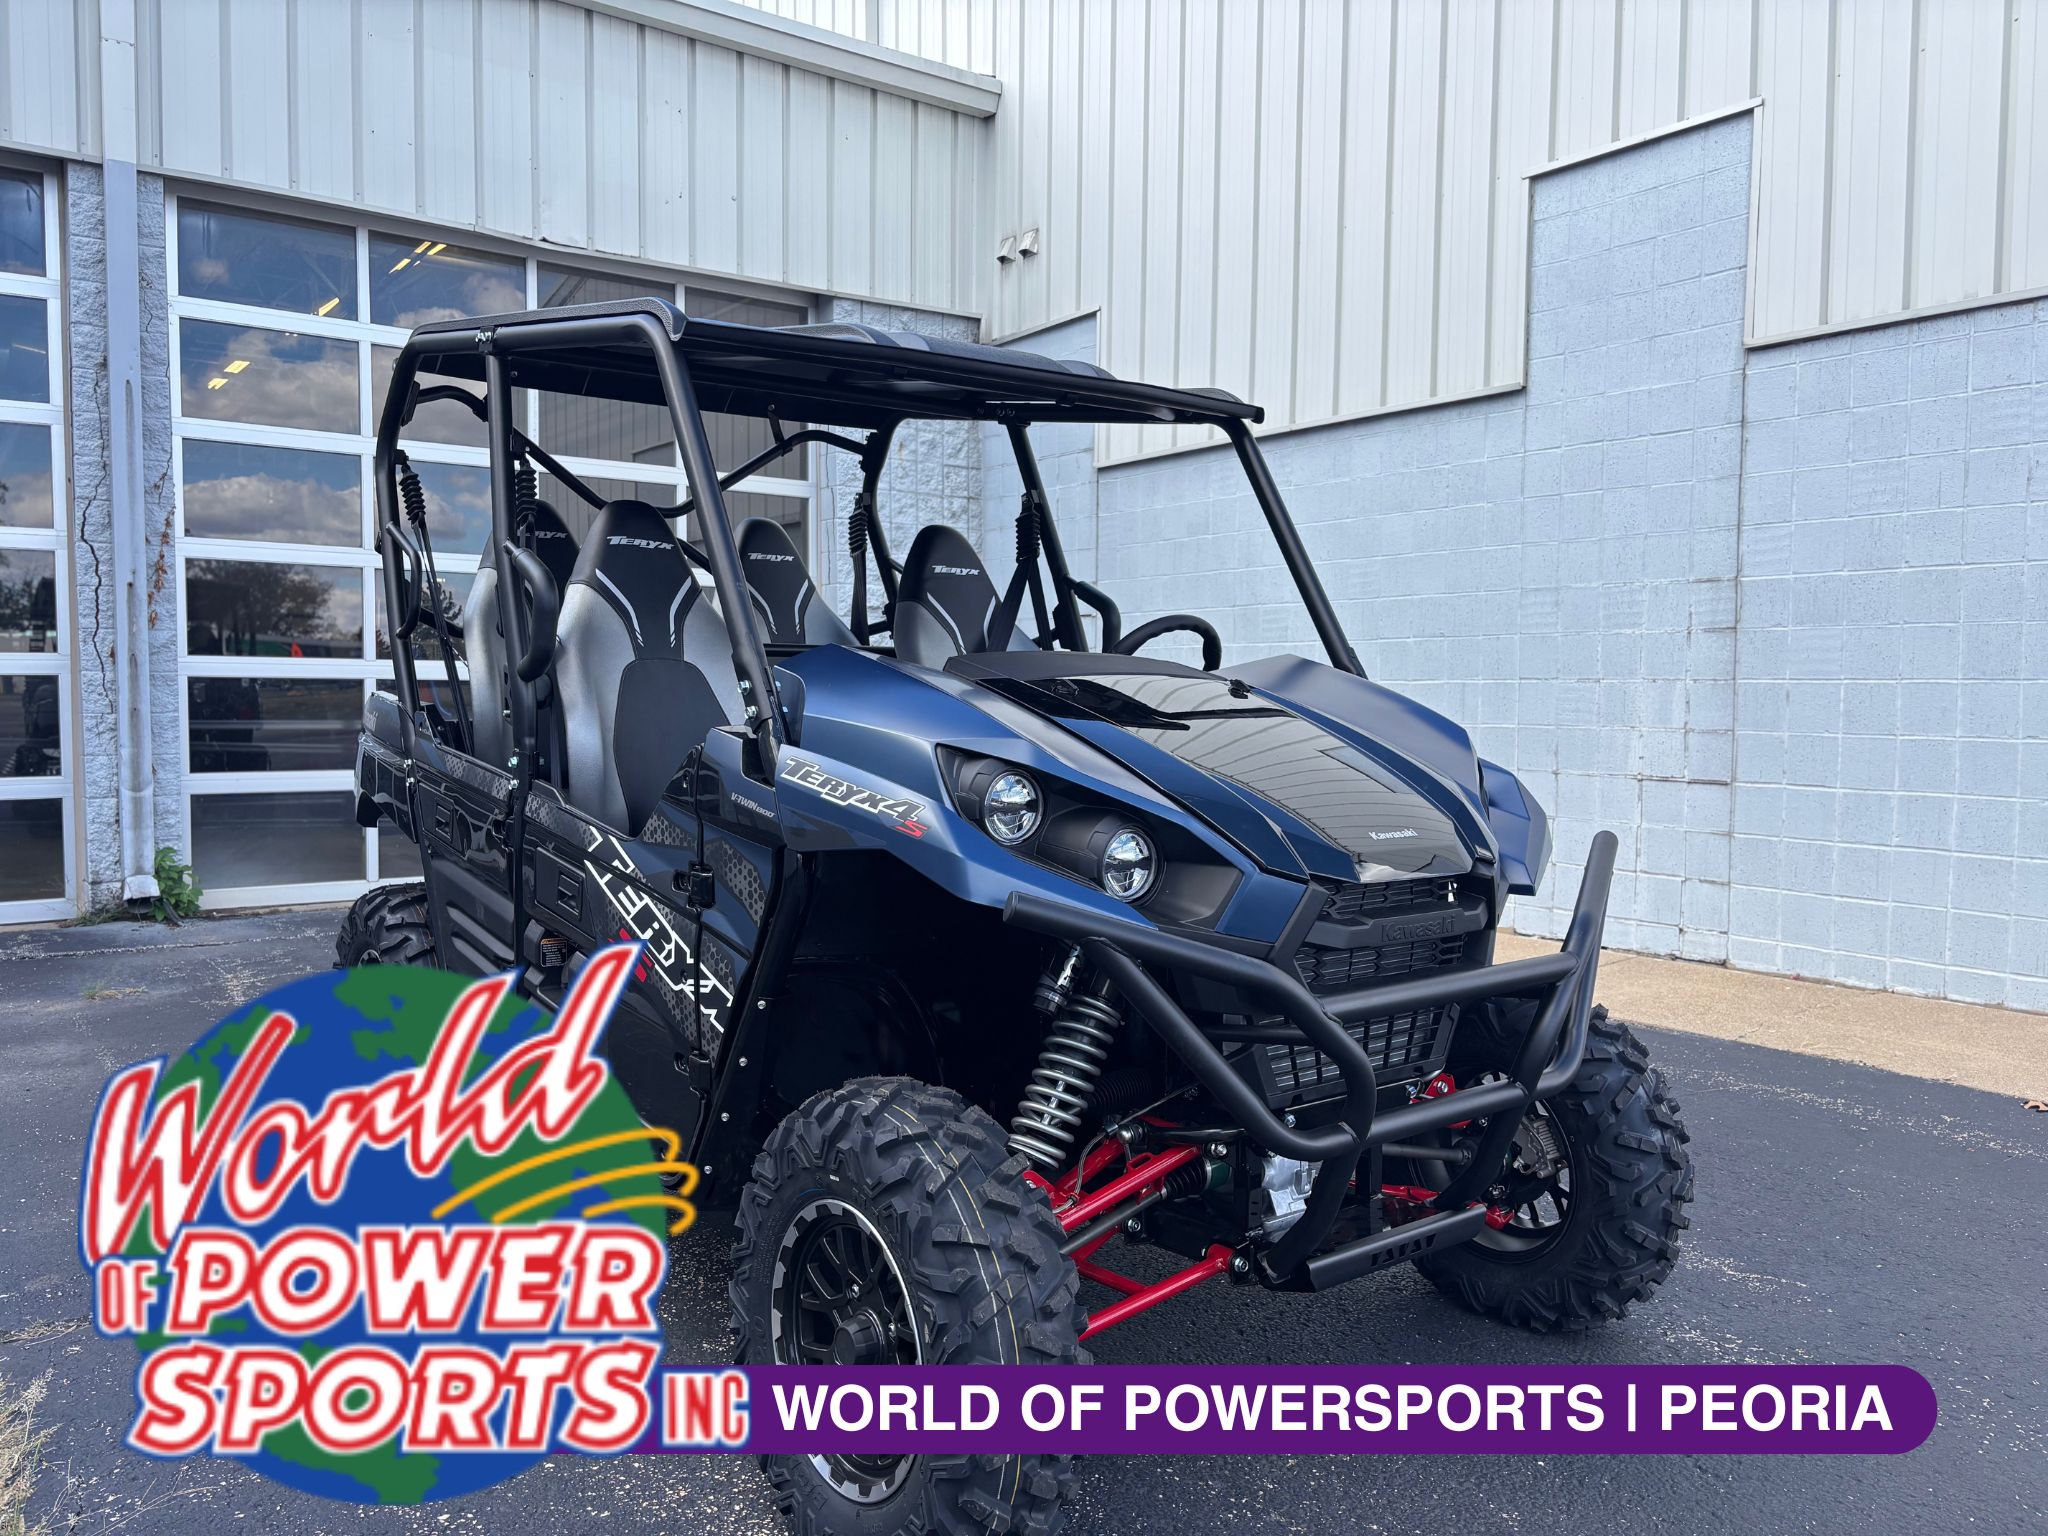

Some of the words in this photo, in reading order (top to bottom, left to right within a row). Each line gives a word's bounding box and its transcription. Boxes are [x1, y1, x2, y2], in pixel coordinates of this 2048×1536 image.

[780, 756, 926, 823] TERYX4
[1369, 828, 1418, 840] Kawasaki
[1381, 913, 1456, 941] Kawasaki
